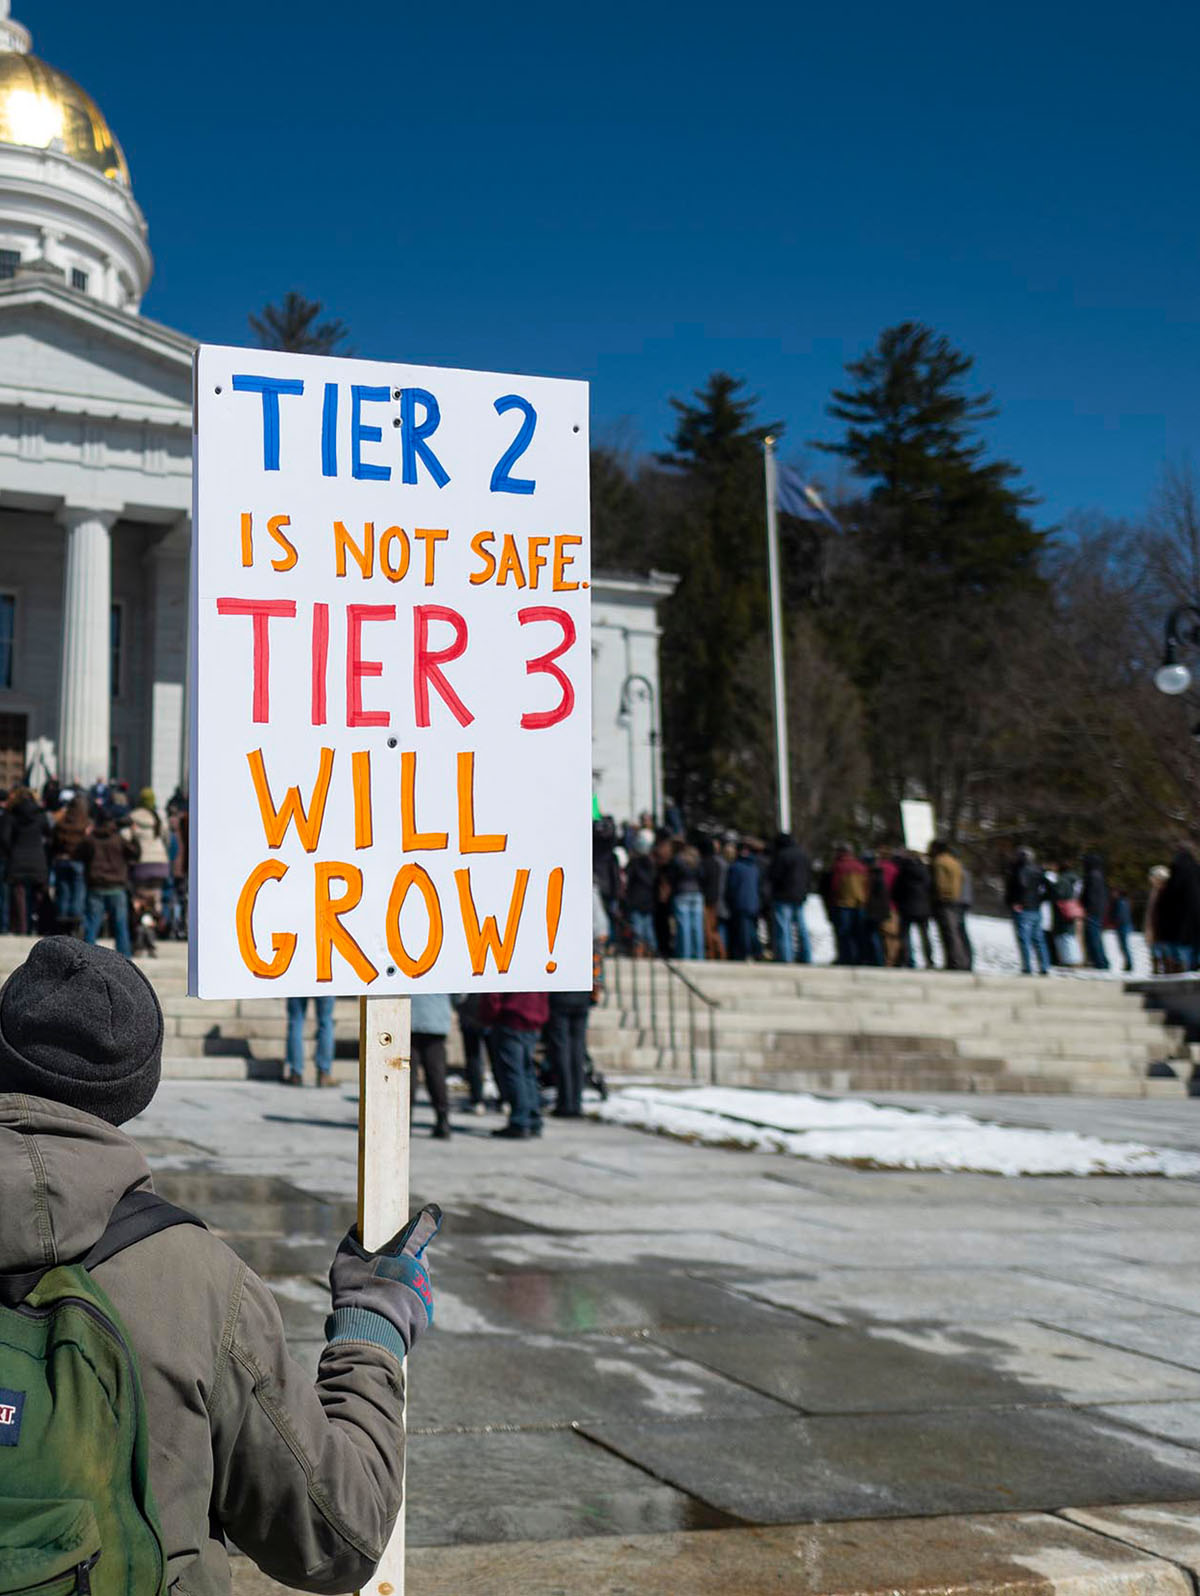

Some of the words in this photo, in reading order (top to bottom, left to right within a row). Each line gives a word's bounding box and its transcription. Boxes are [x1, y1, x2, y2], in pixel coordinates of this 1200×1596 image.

[232, 375, 451, 488] TIER
[490, 395, 537, 495] 2
[241, 513, 298, 572] IS
[334, 522, 449, 585] NOT
[470, 531, 590, 591] SAFE.
[217, 598, 475, 728] TIER
[518, 606, 576, 730] 3
[247, 748, 508, 854] WILL
[236, 859, 564, 984] GROW!
